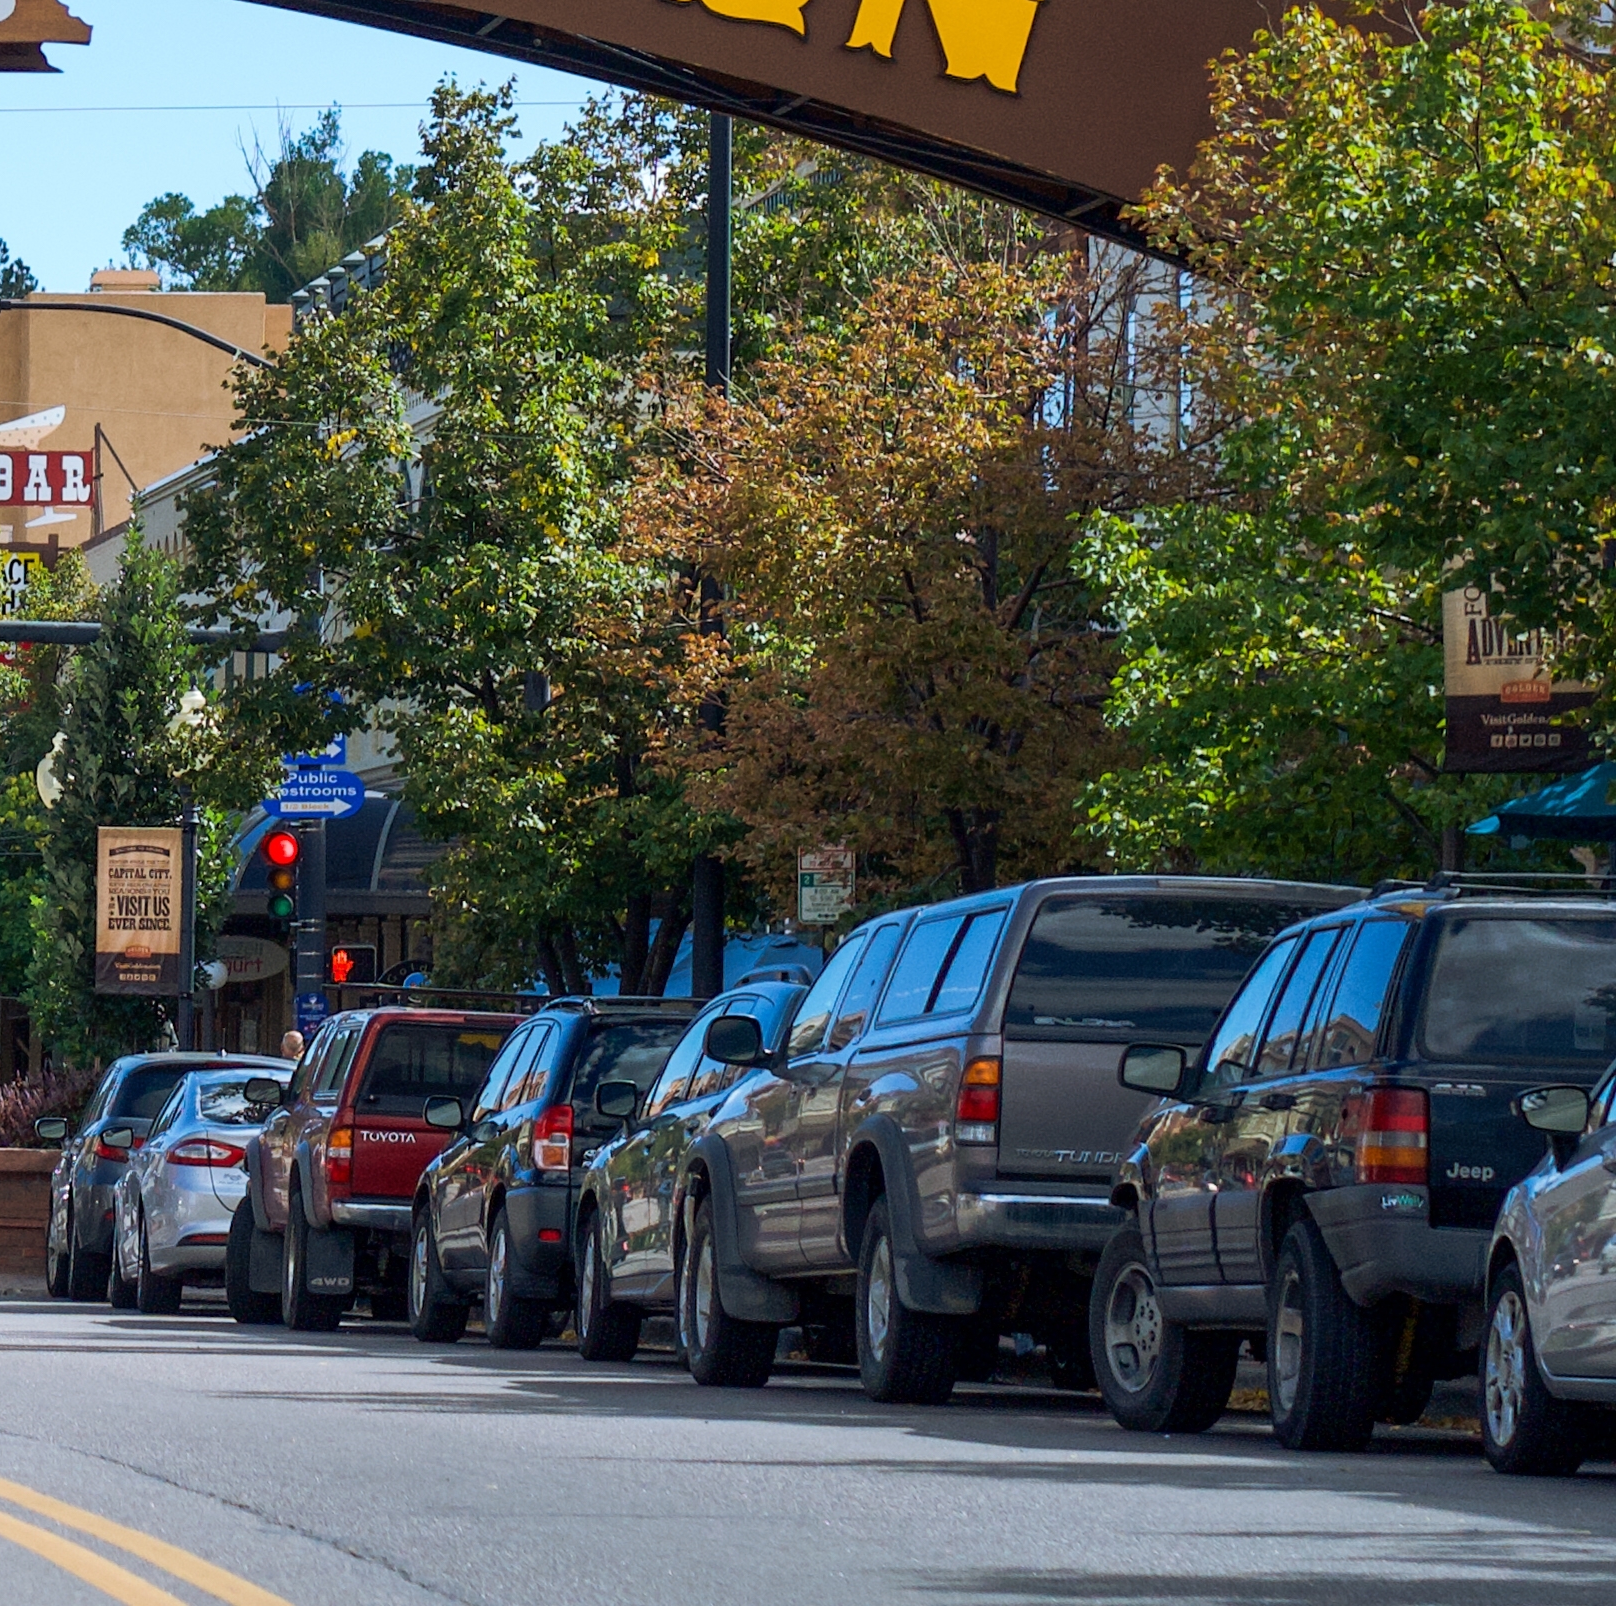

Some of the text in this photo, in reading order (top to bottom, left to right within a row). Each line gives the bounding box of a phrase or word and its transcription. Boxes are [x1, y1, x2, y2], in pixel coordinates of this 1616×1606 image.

[287, 772, 338, 784] Public
[280, 786, 357, 796] estrooms
[109, 868, 172, 880] CAPITAL CITY.
[117, 895, 170, 917] VISIT US
[108, 918, 172, 931] EVER SINCE.
[225, 957, 264, 977] gurt
[360, 1130, 416, 1143] TOYOTA
[1446, 1162, 1495, 1182] Jeep
[311, 1276, 350, 1287] 4WD
